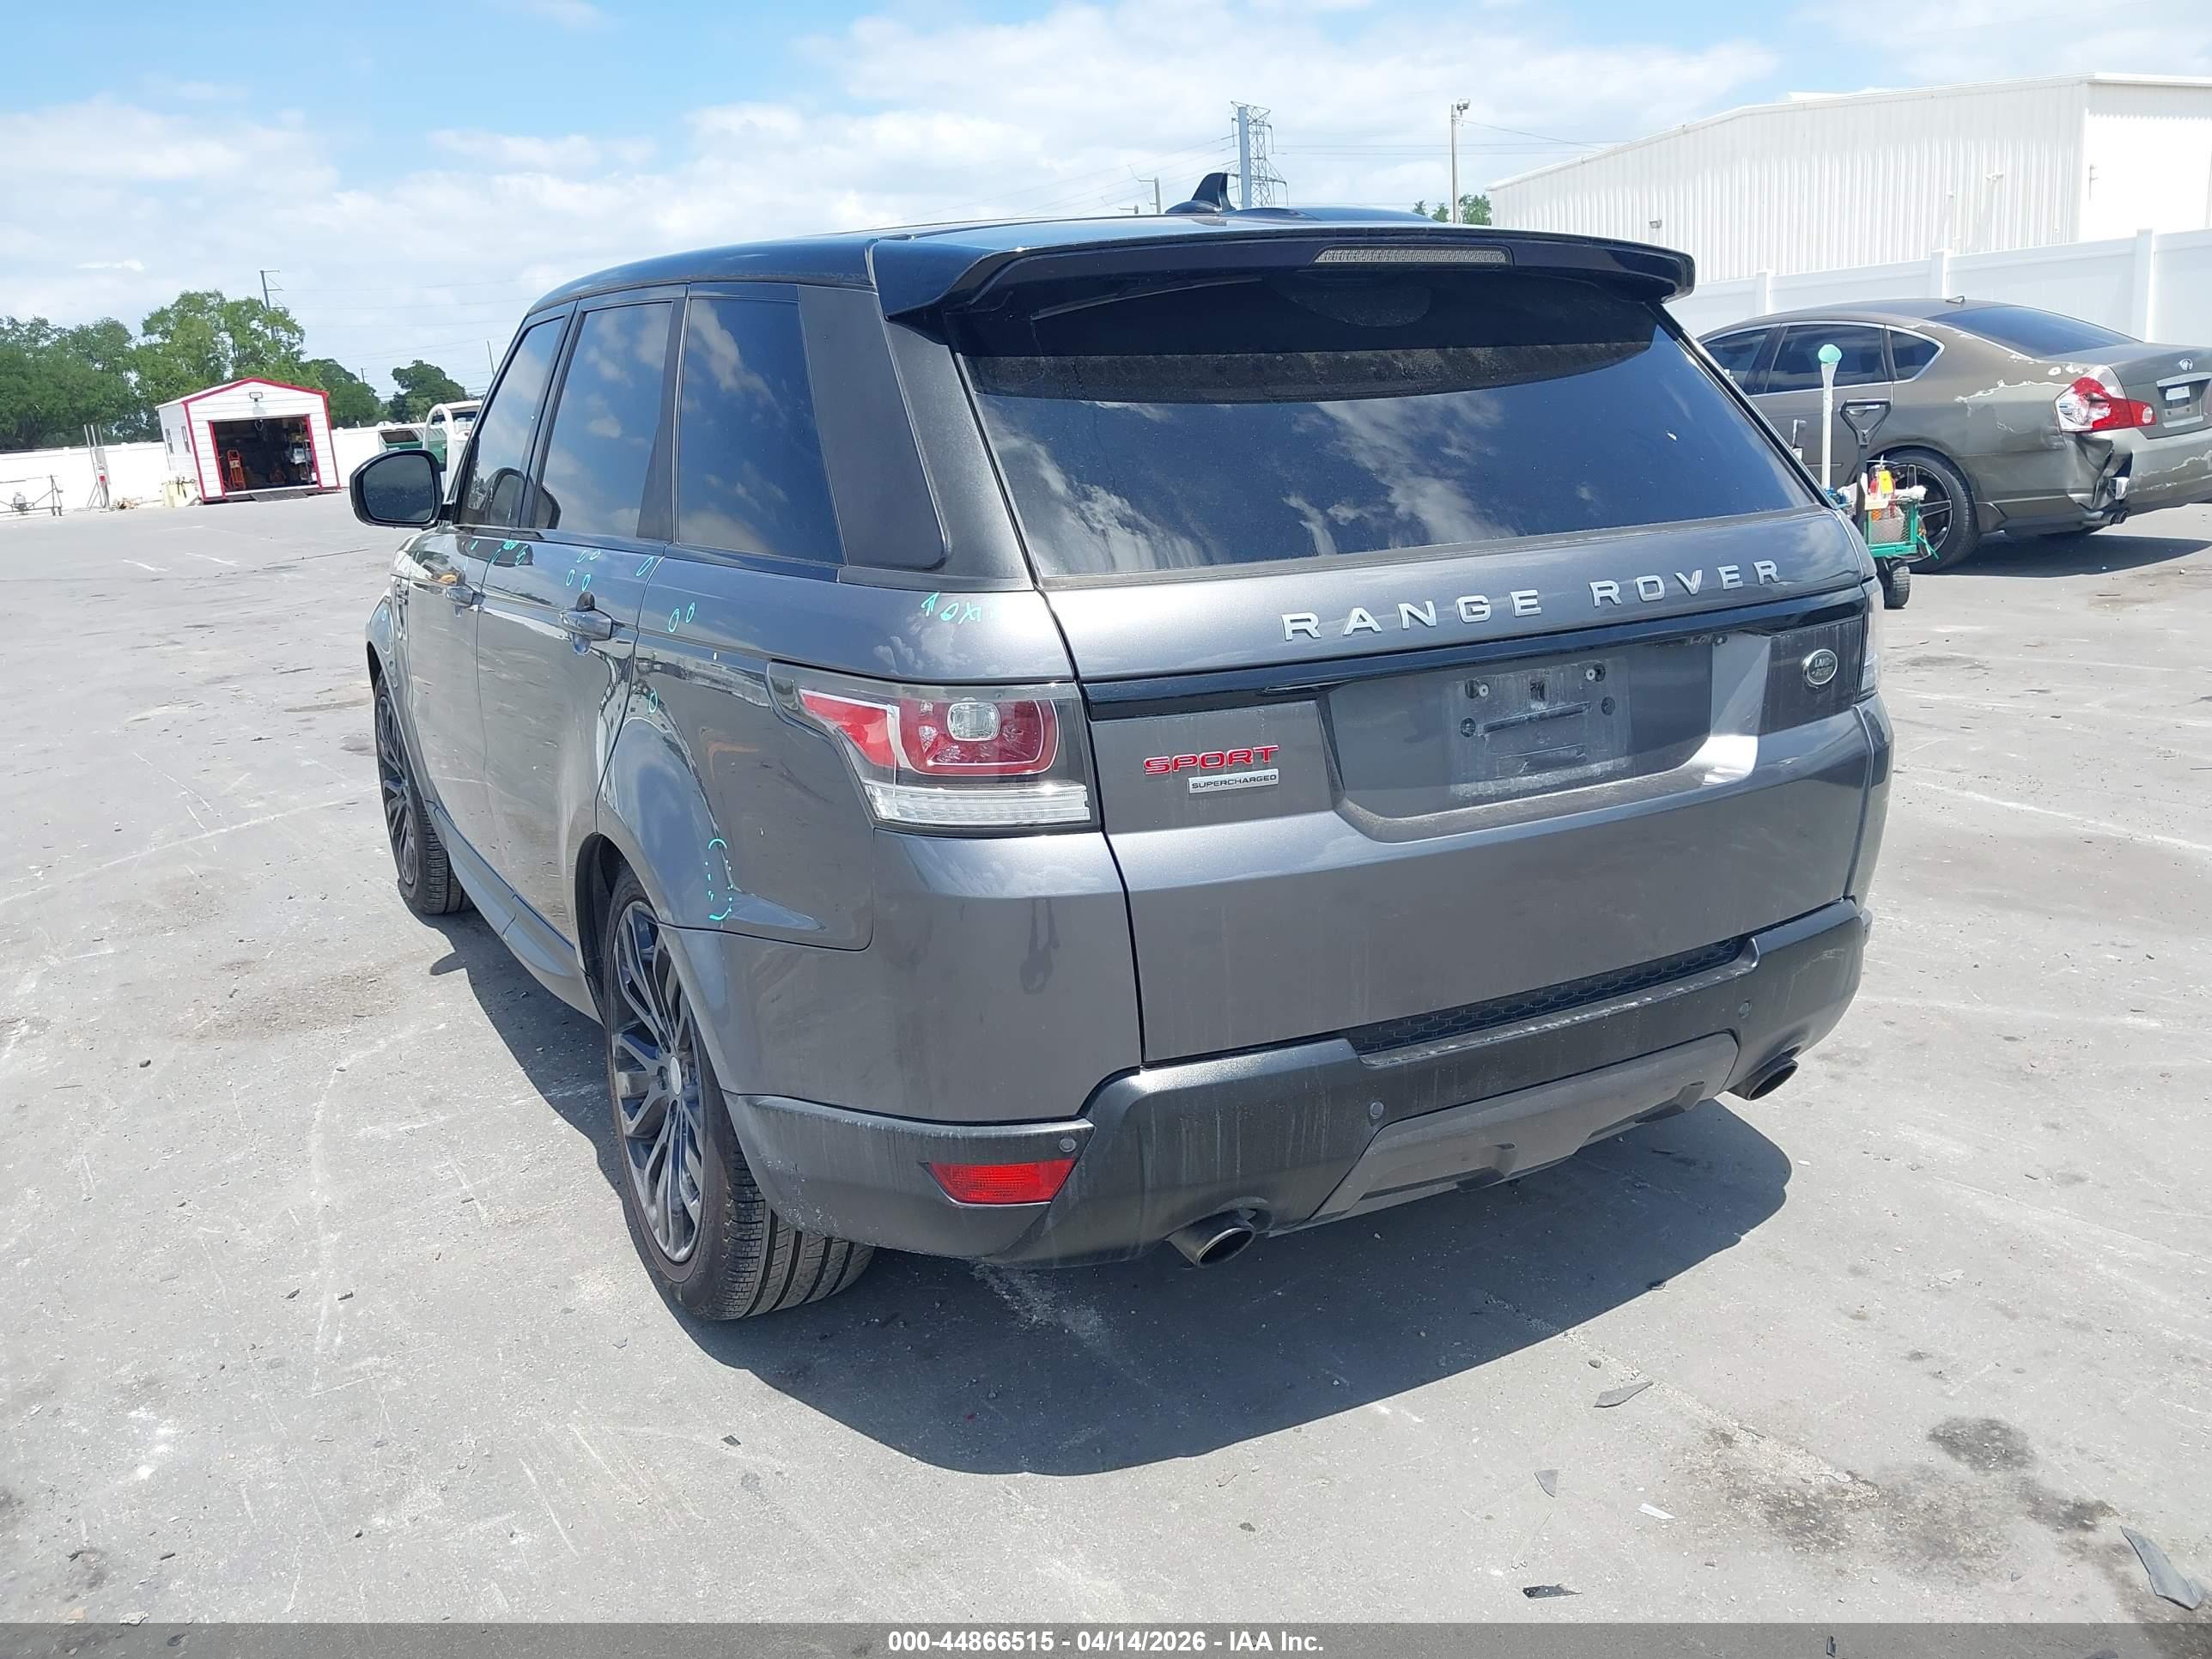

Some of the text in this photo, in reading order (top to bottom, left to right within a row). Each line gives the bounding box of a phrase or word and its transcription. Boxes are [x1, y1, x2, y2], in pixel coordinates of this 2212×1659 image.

[1281, 560, 1779, 641] RANGE ROVER
[1144, 744, 1279, 775] SPORT
[1191, 774, 1277, 789] SUPERCHARGED
